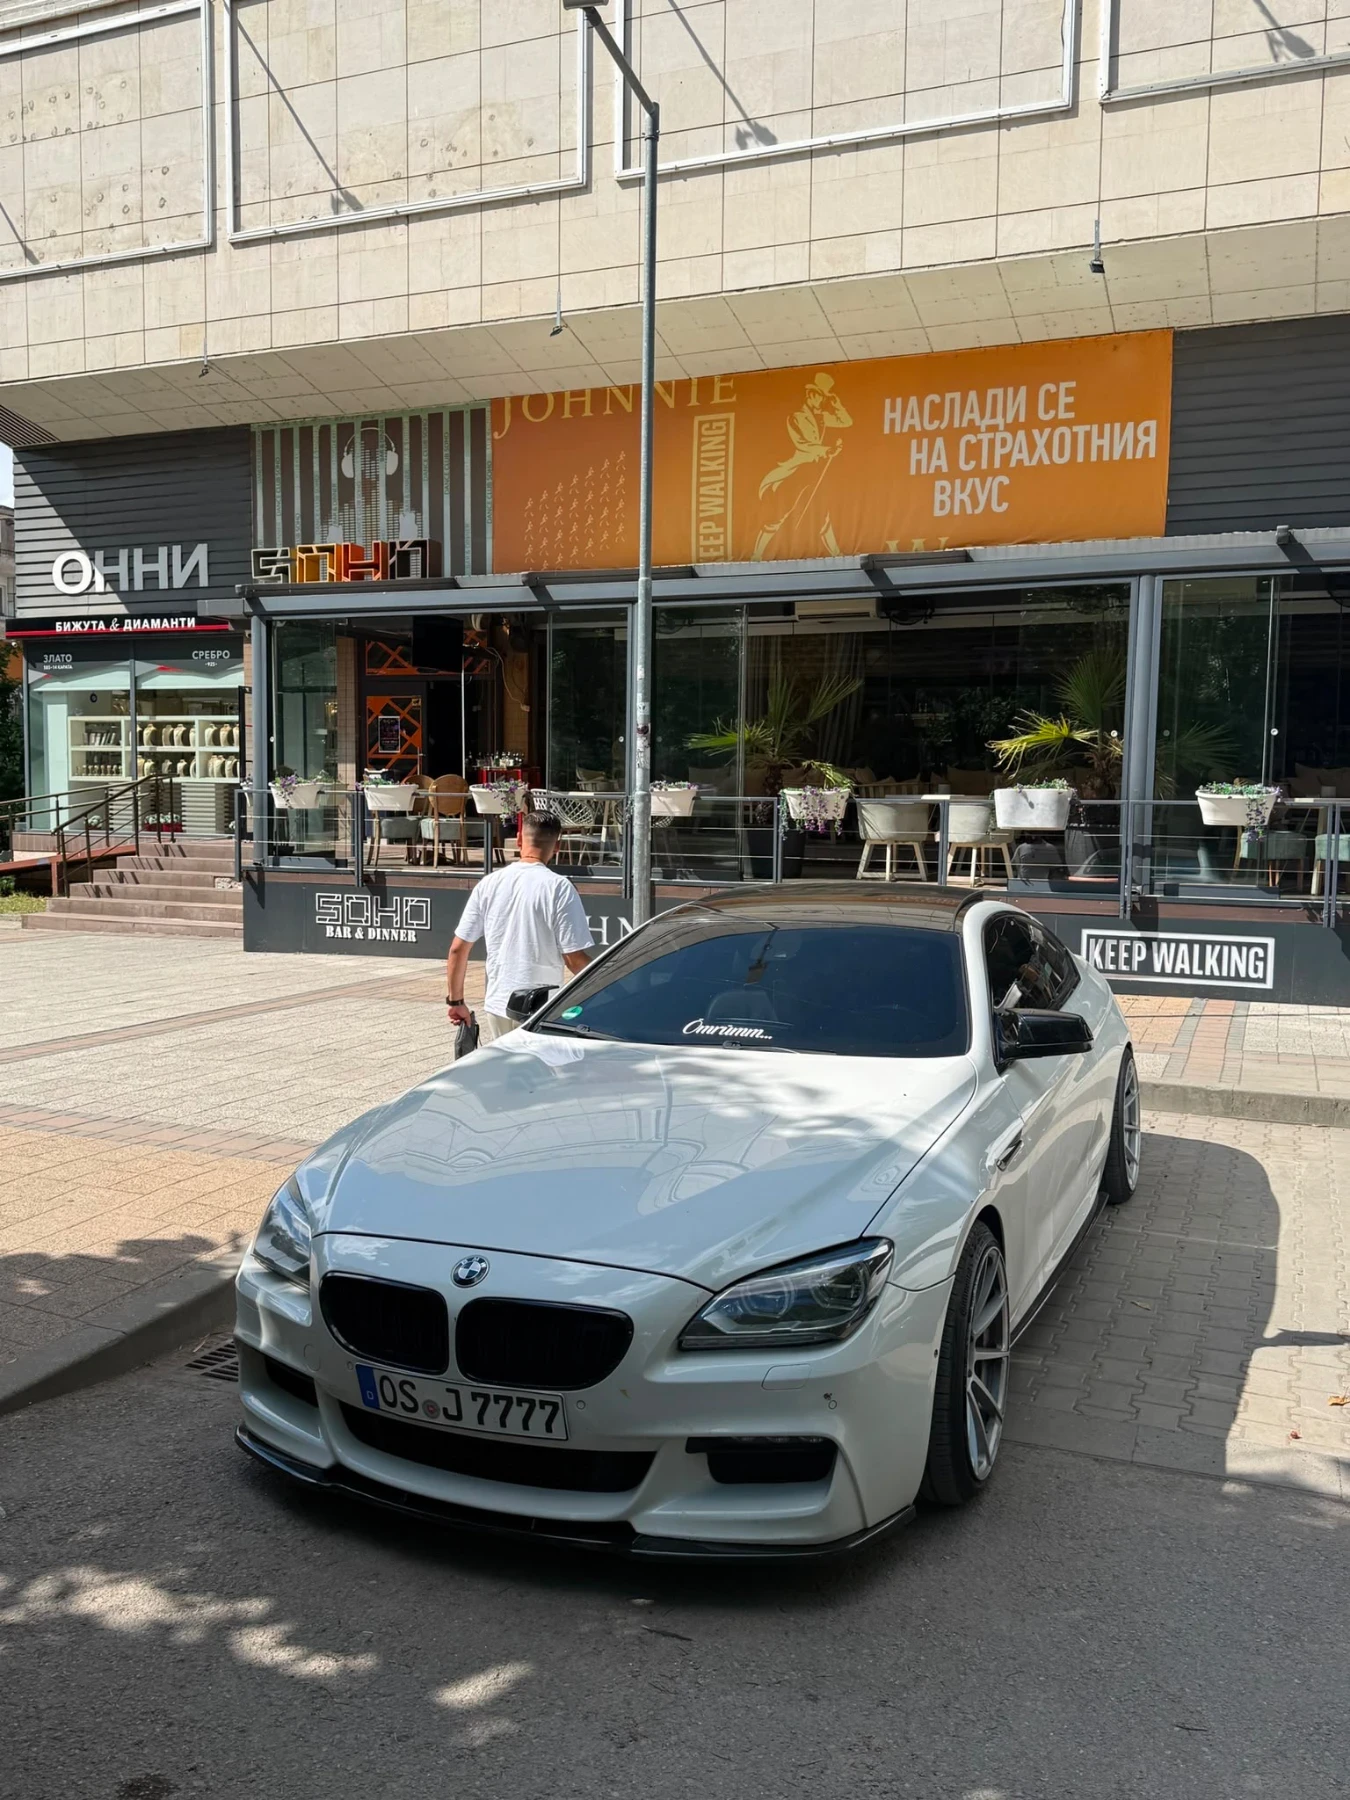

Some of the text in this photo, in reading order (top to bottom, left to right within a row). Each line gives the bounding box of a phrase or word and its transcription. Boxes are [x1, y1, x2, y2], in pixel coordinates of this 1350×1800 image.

[884, 381, 1077, 433] НАСЛАДИ СЕ
[909, 420, 1157, 476] НА СТРАХОТНИЯ
[699, 421, 727, 561] EEP WALKING
[933, 475, 1010, 517] ВКУС
[52, 543, 209, 594] ОННИ
[251, 537, 434, 584] SOHO
[55, 617, 196, 632] БИЖУТА & ДИАМАНТИ
[43, 653, 73, 663] ЗЛАТО
[192, 650, 231, 660] СРЕБРО
[315, 892, 431, 930] SOHO
[325, 925, 417, 943] BAR & DINNER
[1088, 938, 1265, 979] KEEP WALKING
[379, 1375, 420, 1414] OS
